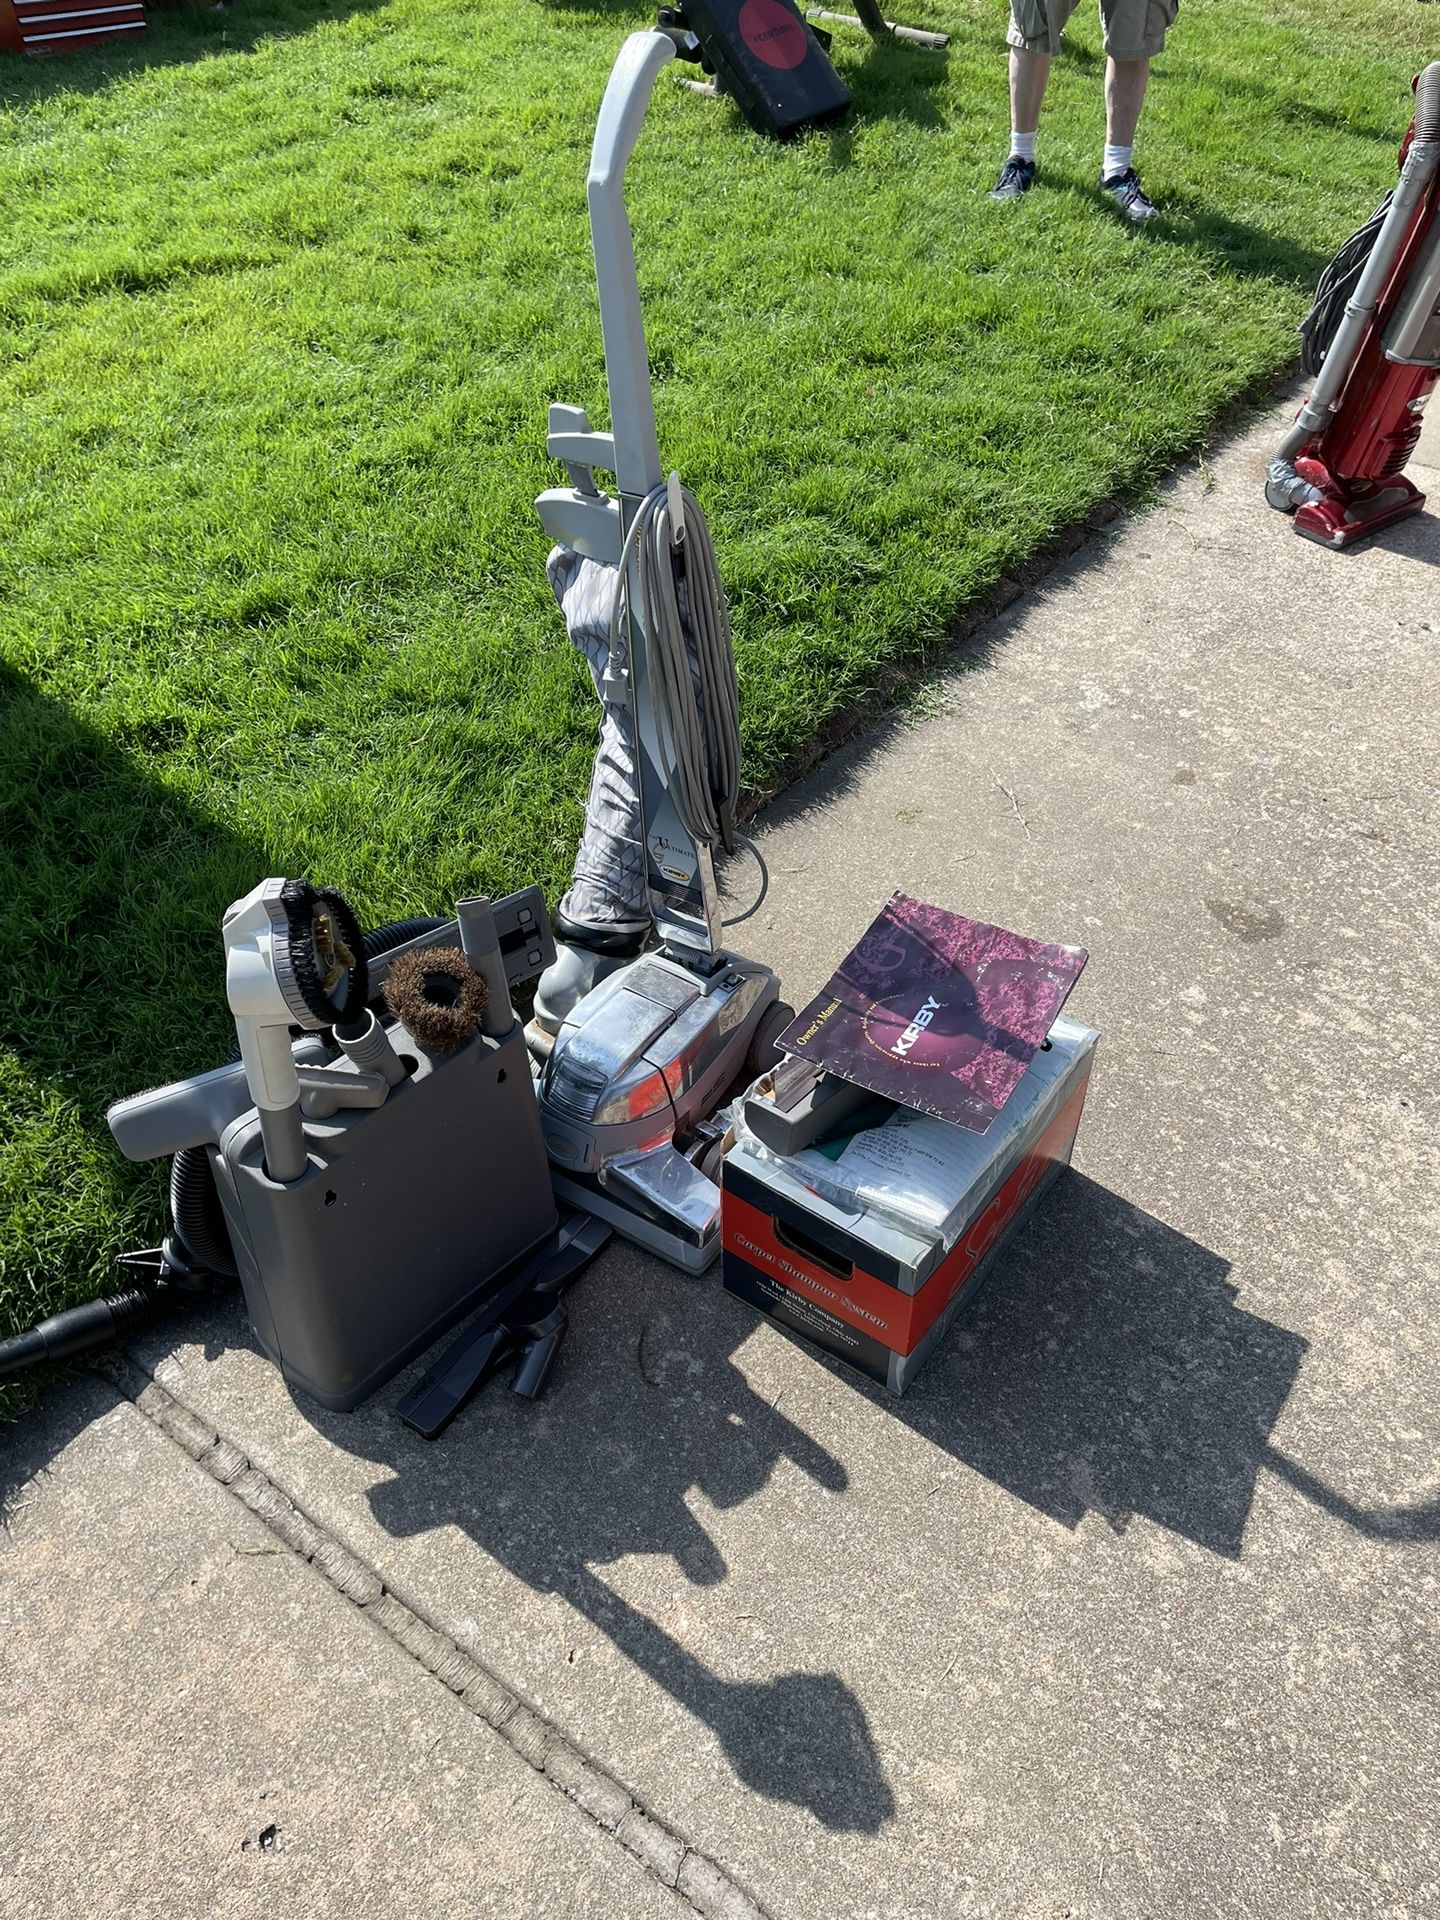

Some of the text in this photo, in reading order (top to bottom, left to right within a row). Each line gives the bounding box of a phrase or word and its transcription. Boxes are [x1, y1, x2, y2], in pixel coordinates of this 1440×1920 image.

[796, 997, 842, 1045] Owner's Manual
[890, 995, 940, 1056] KIRBY
[735, 1233, 888, 1330] Carpet Shampoo System
[770, 1280, 844, 1328] The Kirby Company
